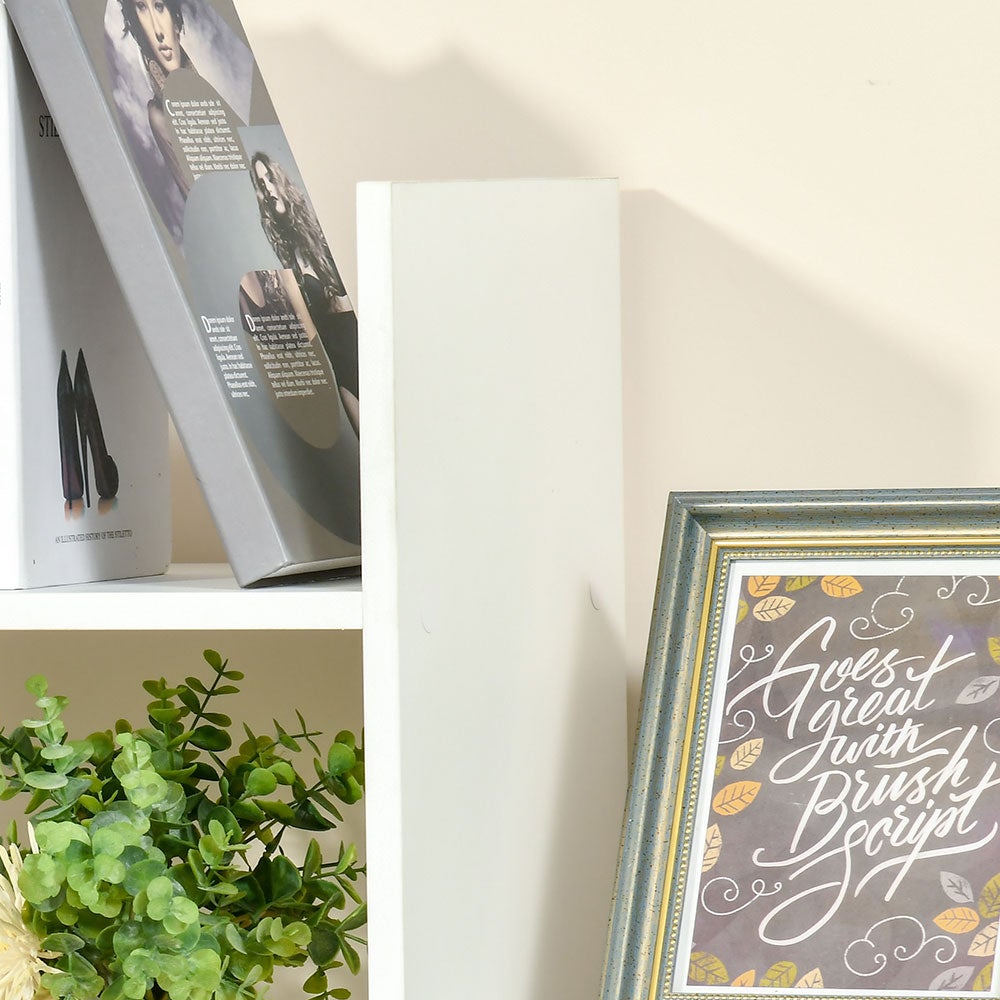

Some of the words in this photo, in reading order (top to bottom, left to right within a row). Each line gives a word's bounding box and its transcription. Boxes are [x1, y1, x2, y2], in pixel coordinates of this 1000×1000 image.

[726, 616, 925, 739] Goes
[769, 635, 976, 784] great
[830, 718, 963, 769] with
[752, 725, 978, 867] Brush
[759, 762, 1000, 946] Script
